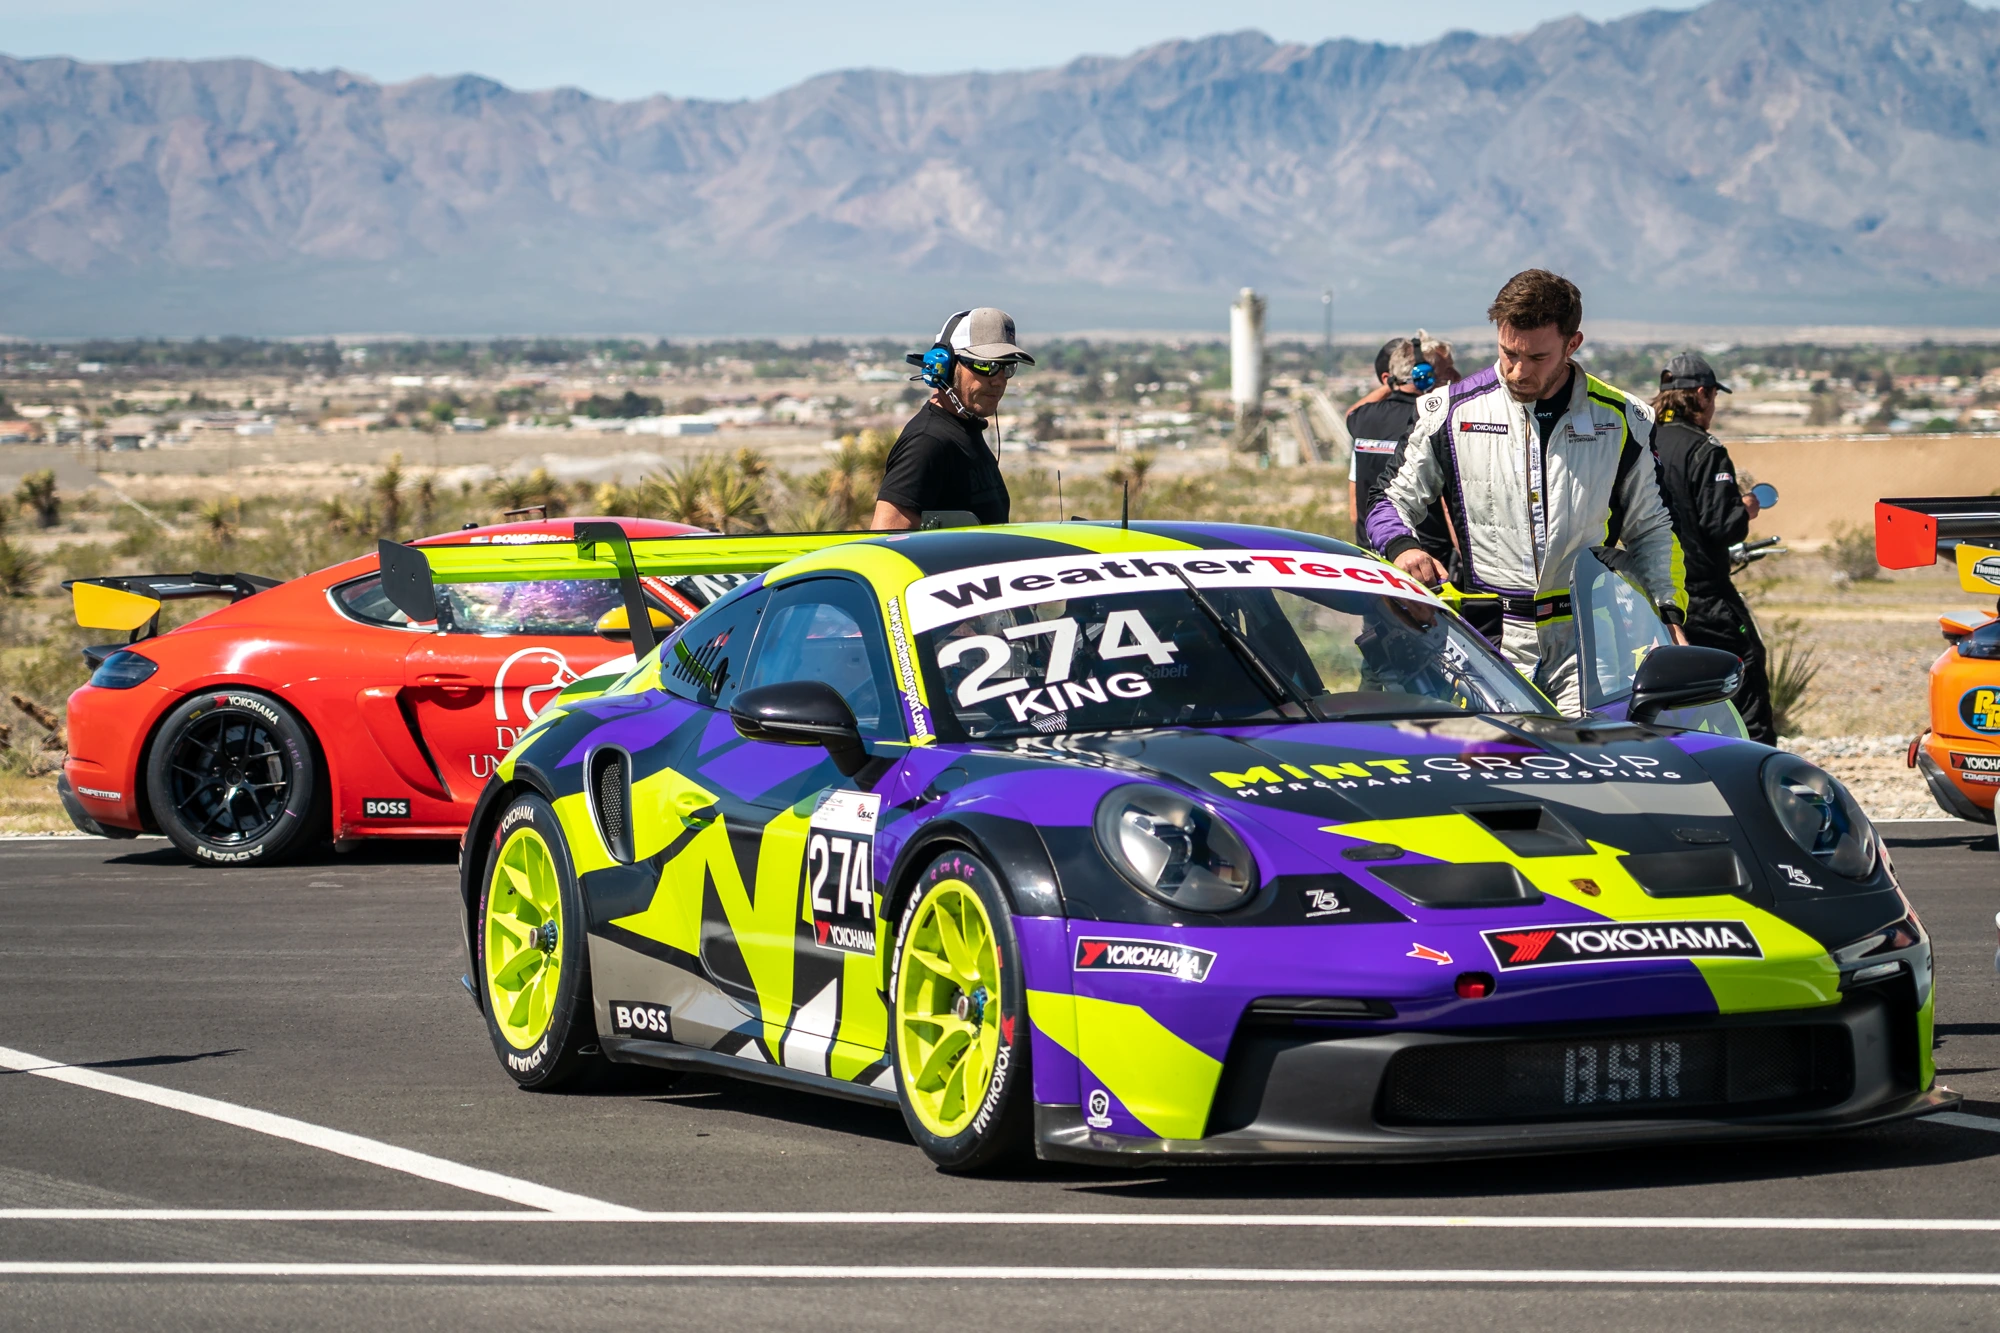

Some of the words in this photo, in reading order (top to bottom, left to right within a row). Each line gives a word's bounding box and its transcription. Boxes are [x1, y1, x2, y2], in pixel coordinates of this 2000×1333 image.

[1472, 423, 1507, 433] YOKOHAMA
[930, 556, 1428, 609] WeatherTech
[887, 595, 928, 740] www.porschemotorsport.com
[937, 609, 1179, 708] 274
[1141, 663, 1189, 680] Sabelt
[228, 696, 280, 725] YOKOHAMA
[1005, 672, 1152, 723] KING
[78, 786, 121, 799] COMPETITION
[1236, 773, 1432, 798] MERCHANT
[1460, 770, 1682, 780] PROCESSING
[366, 801, 407, 815] BOSS
[501, 805, 534, 833] YOKOHAMA
[197, 844, 263, 862] ADVAN
[809, 834, 872, 919] 274
[1778, 864, 1811, 884] 75
[1306, 889, 1339, 910] 75
[829, 925, 876, 951] YOKOHAMA
[889, 883, 922, 1003] ADVAN
[1556, 926, 1747, 954] YOKOHAMA
[1106, 945, 1201, 973] YOKOHAMA
[617, 1006, 668, 1034] BOSS
[508, 1033, 549, 1072] ADVAN
[1564, 1041, 1681, 1104] BSR
[973, 1045, 1011, 1135] YOKOHAMA
